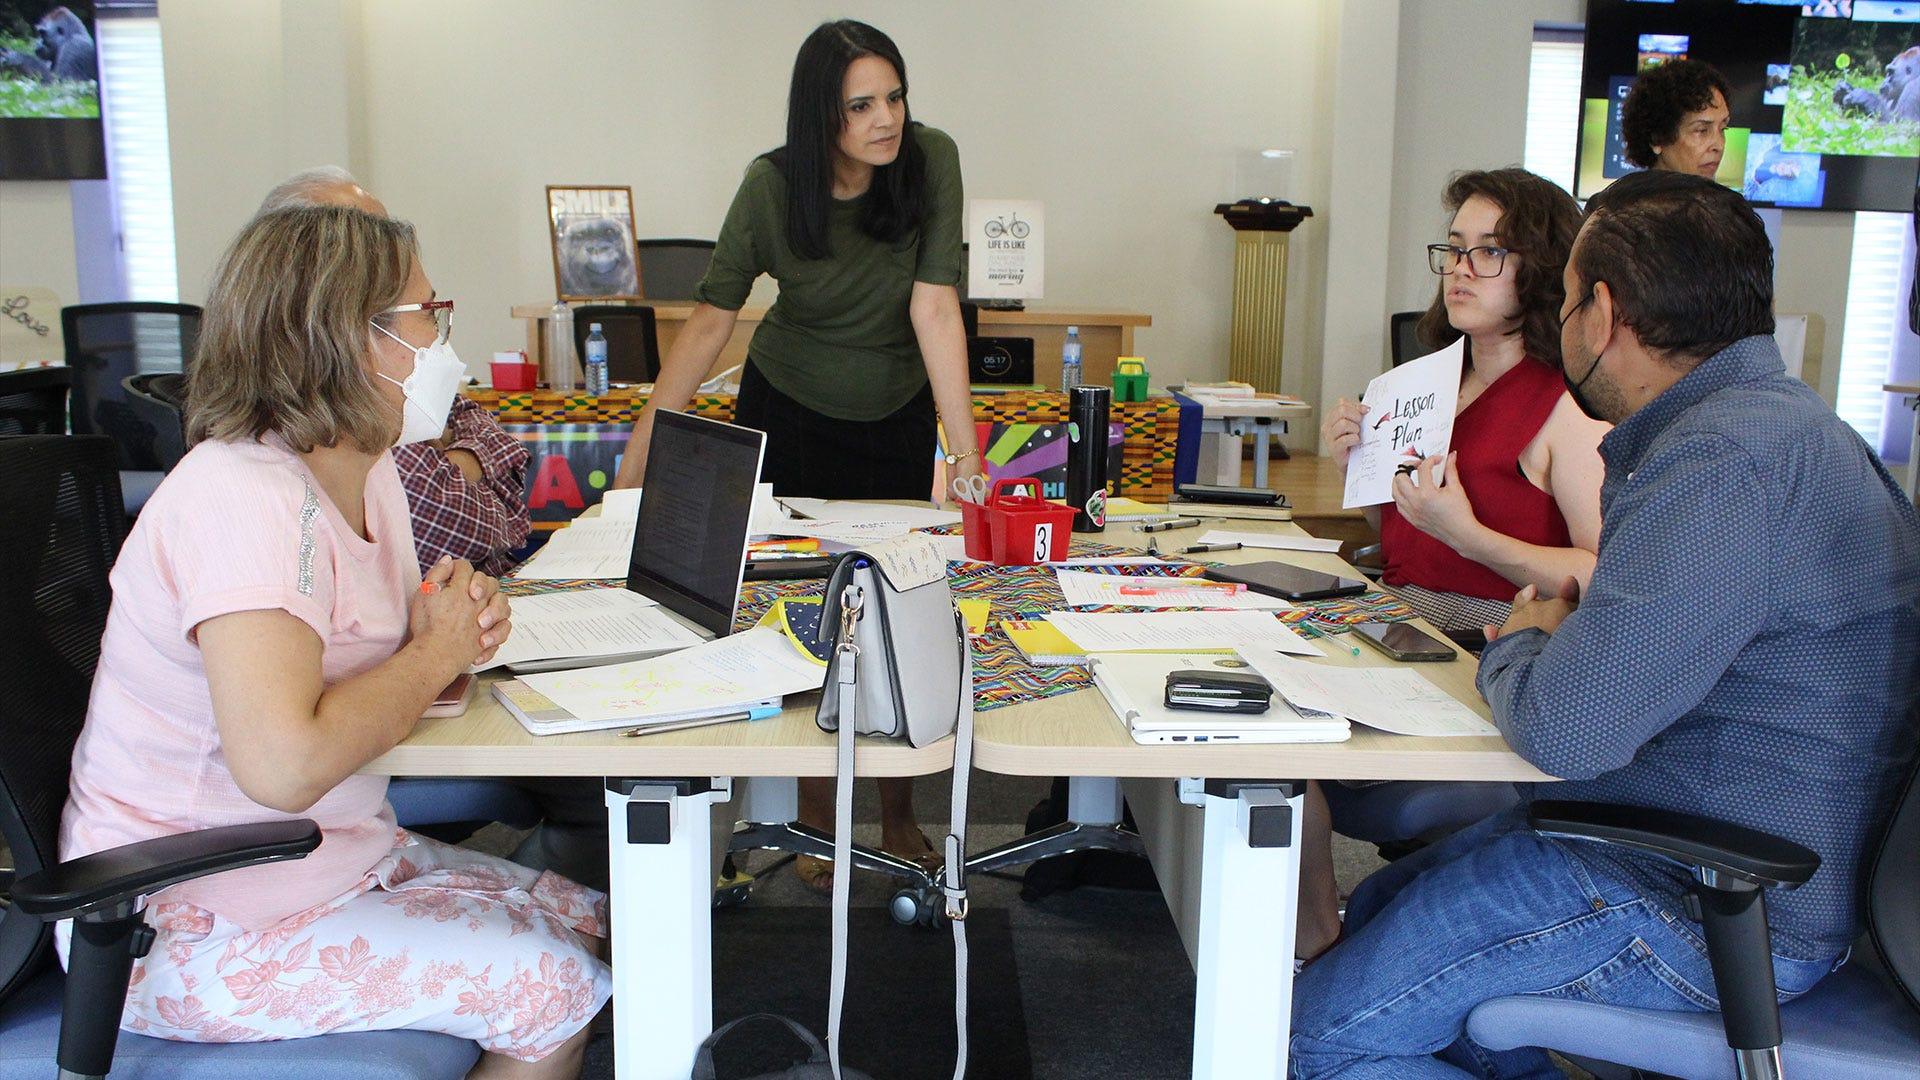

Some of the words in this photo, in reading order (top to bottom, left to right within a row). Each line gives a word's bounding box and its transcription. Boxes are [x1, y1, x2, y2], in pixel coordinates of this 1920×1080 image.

[551, 190, 630, 214] SMILE
[988, 240, 1001, 249] LIFE
[1003, 240, 1010, 249] IS
[1011, 240, 1026, 249] LIKE
[988, 269, 1024, 284] moving
[2, 295, 49, 336] Love
[1391, 392, 1435, 420] Lesson
[1391, 422, 1423, 451] Plan
[1036, 526, 1047, 560] 3
